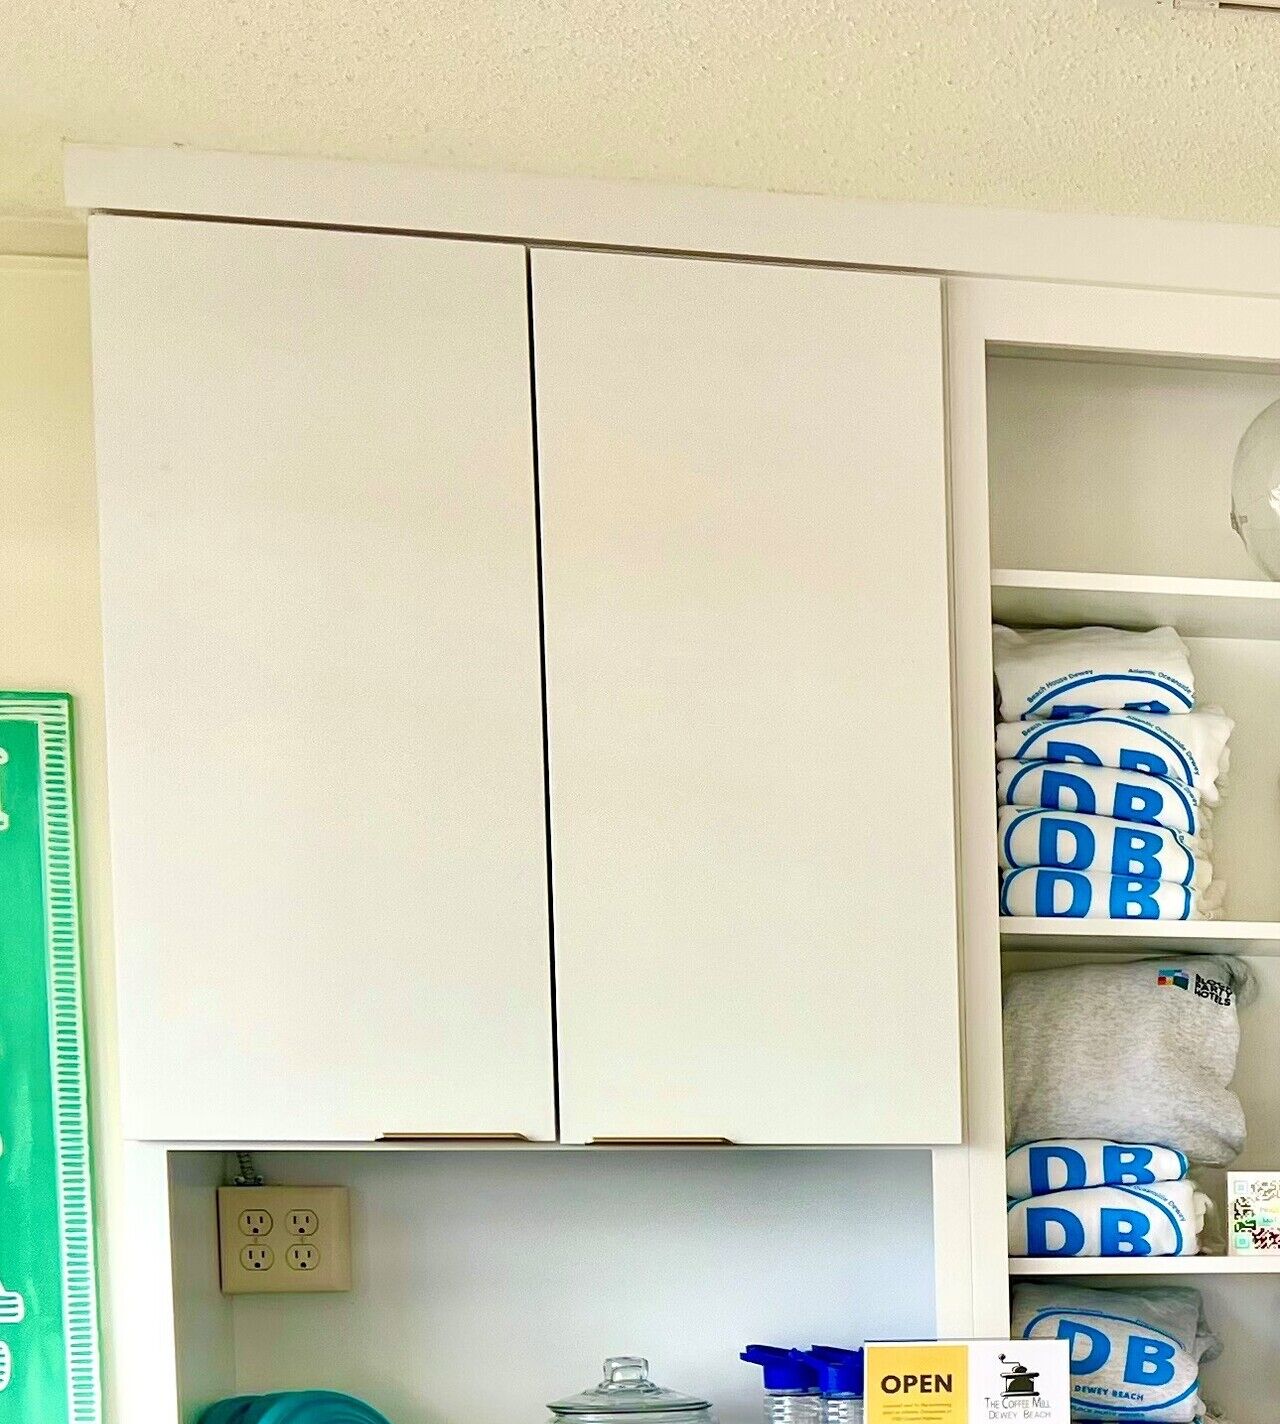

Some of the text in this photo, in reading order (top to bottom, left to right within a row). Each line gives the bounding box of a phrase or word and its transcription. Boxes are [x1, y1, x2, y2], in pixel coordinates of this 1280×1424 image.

[1038, 817, 1164, 879] DB
[1035, 869, 1161, 919] DB
[1194, 981, 1233, 998] PARTY
[1194, 991, 1231, 1006] HOTELS
[1029, 1145, 1156, 1197] DB
[1026, 1207, 1153, 1256] DB
[1057, 1319, 1176, 1387] DB
[881, 1374, 953, 1394] OPEN
[1074, 1384, 1145, 1401] DEWEY BEACH
